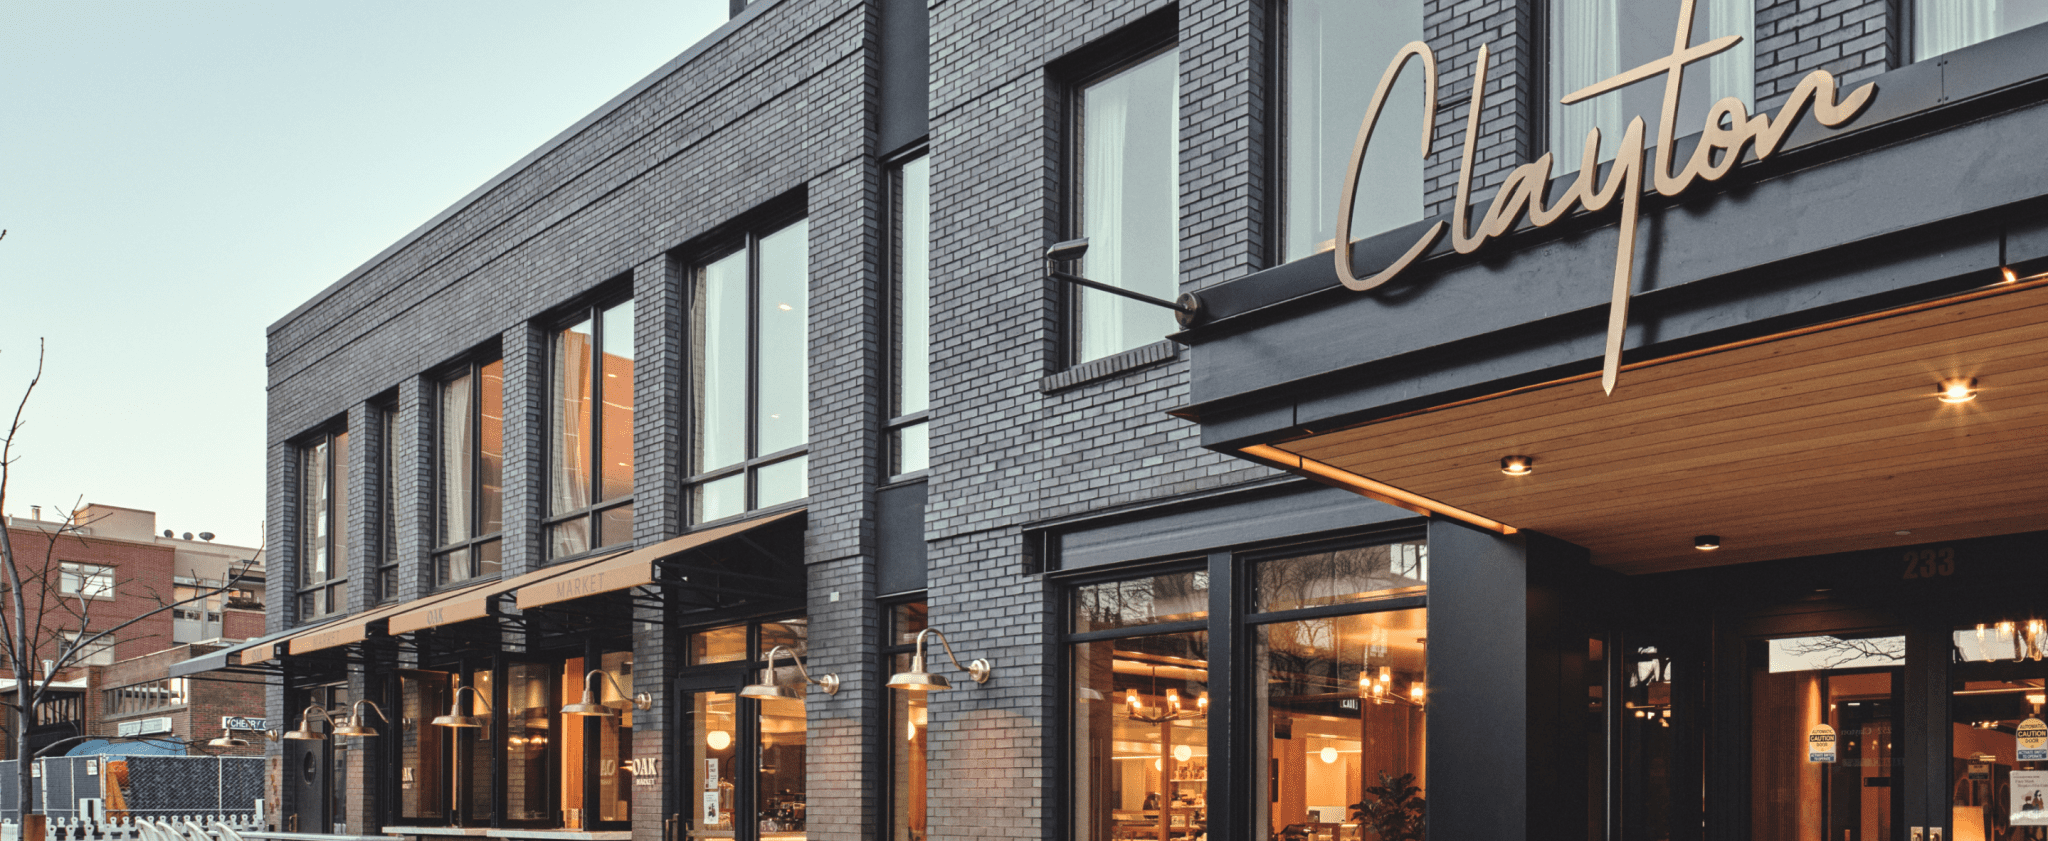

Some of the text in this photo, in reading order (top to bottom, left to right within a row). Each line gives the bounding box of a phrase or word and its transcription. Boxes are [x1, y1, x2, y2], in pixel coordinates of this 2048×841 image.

[1335, 0, 1877, 397] Clayton
[1903, 547, 1955, 580] 233
[556, 572, 606, 598] MARKET
[427, 608, 444, 625] OAK
[633, 757, 658, 775] OAK
[636, 778, 655, 786] MARKET
